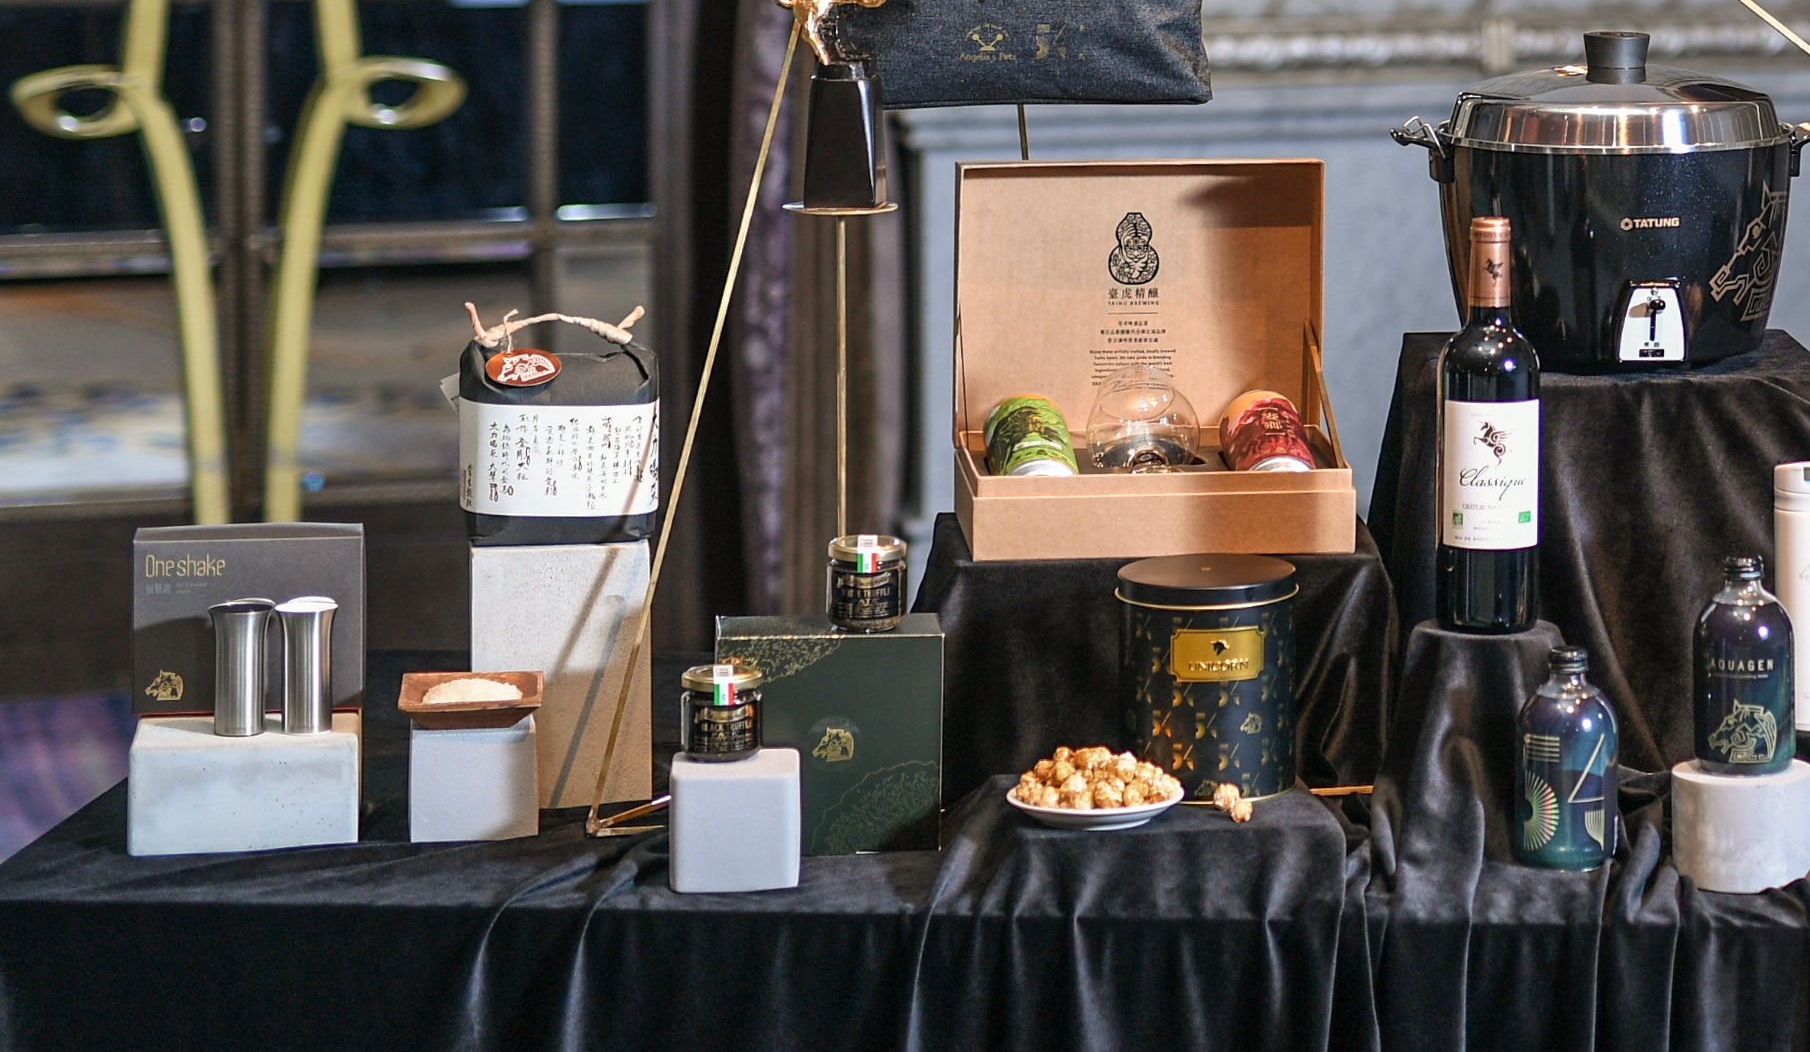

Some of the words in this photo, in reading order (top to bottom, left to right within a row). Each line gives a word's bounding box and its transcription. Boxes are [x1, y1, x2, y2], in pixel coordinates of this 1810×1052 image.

[1633, 218, 1680, 228] TATUNG
[1459, 465, 1526, 501] Classique
[145, 554, 175, 578] One
[176, 553, 226, 578] shake
[1187, 656, 1250, 673] UNICORN
[1709, 659, 1774, 672] AQUAGEN
